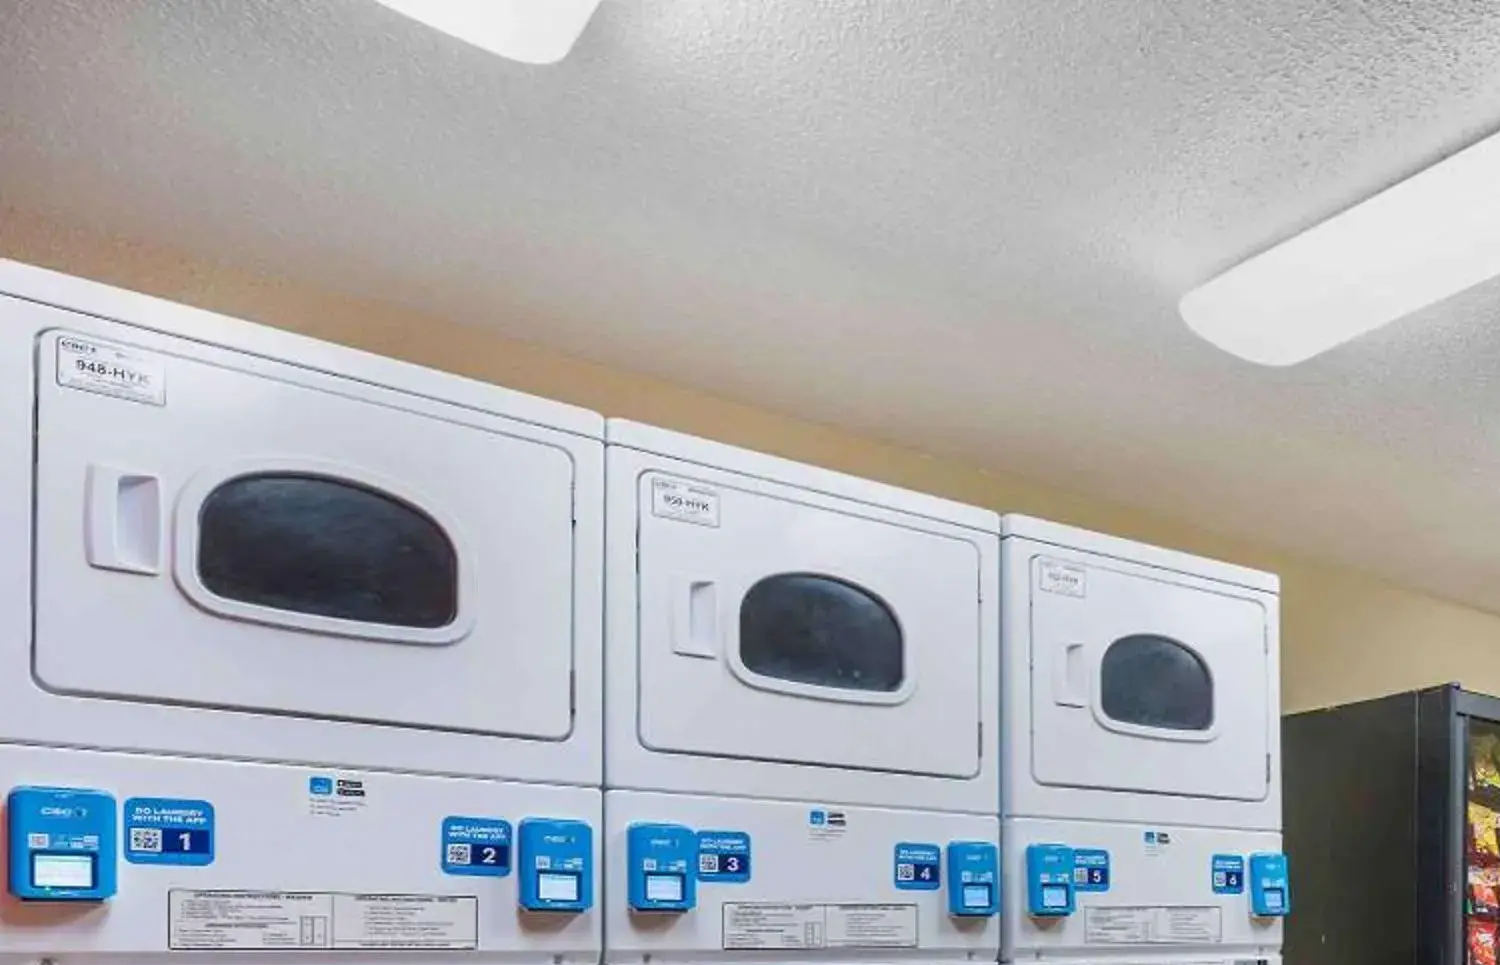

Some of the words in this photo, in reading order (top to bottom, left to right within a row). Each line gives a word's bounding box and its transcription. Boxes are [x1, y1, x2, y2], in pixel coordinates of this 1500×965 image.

[179, 832, 191, 851] 1
[482, 847, 497, 863] 2
[727, 857, 740, 872] 3
[920, 867, 932, 880] 4
